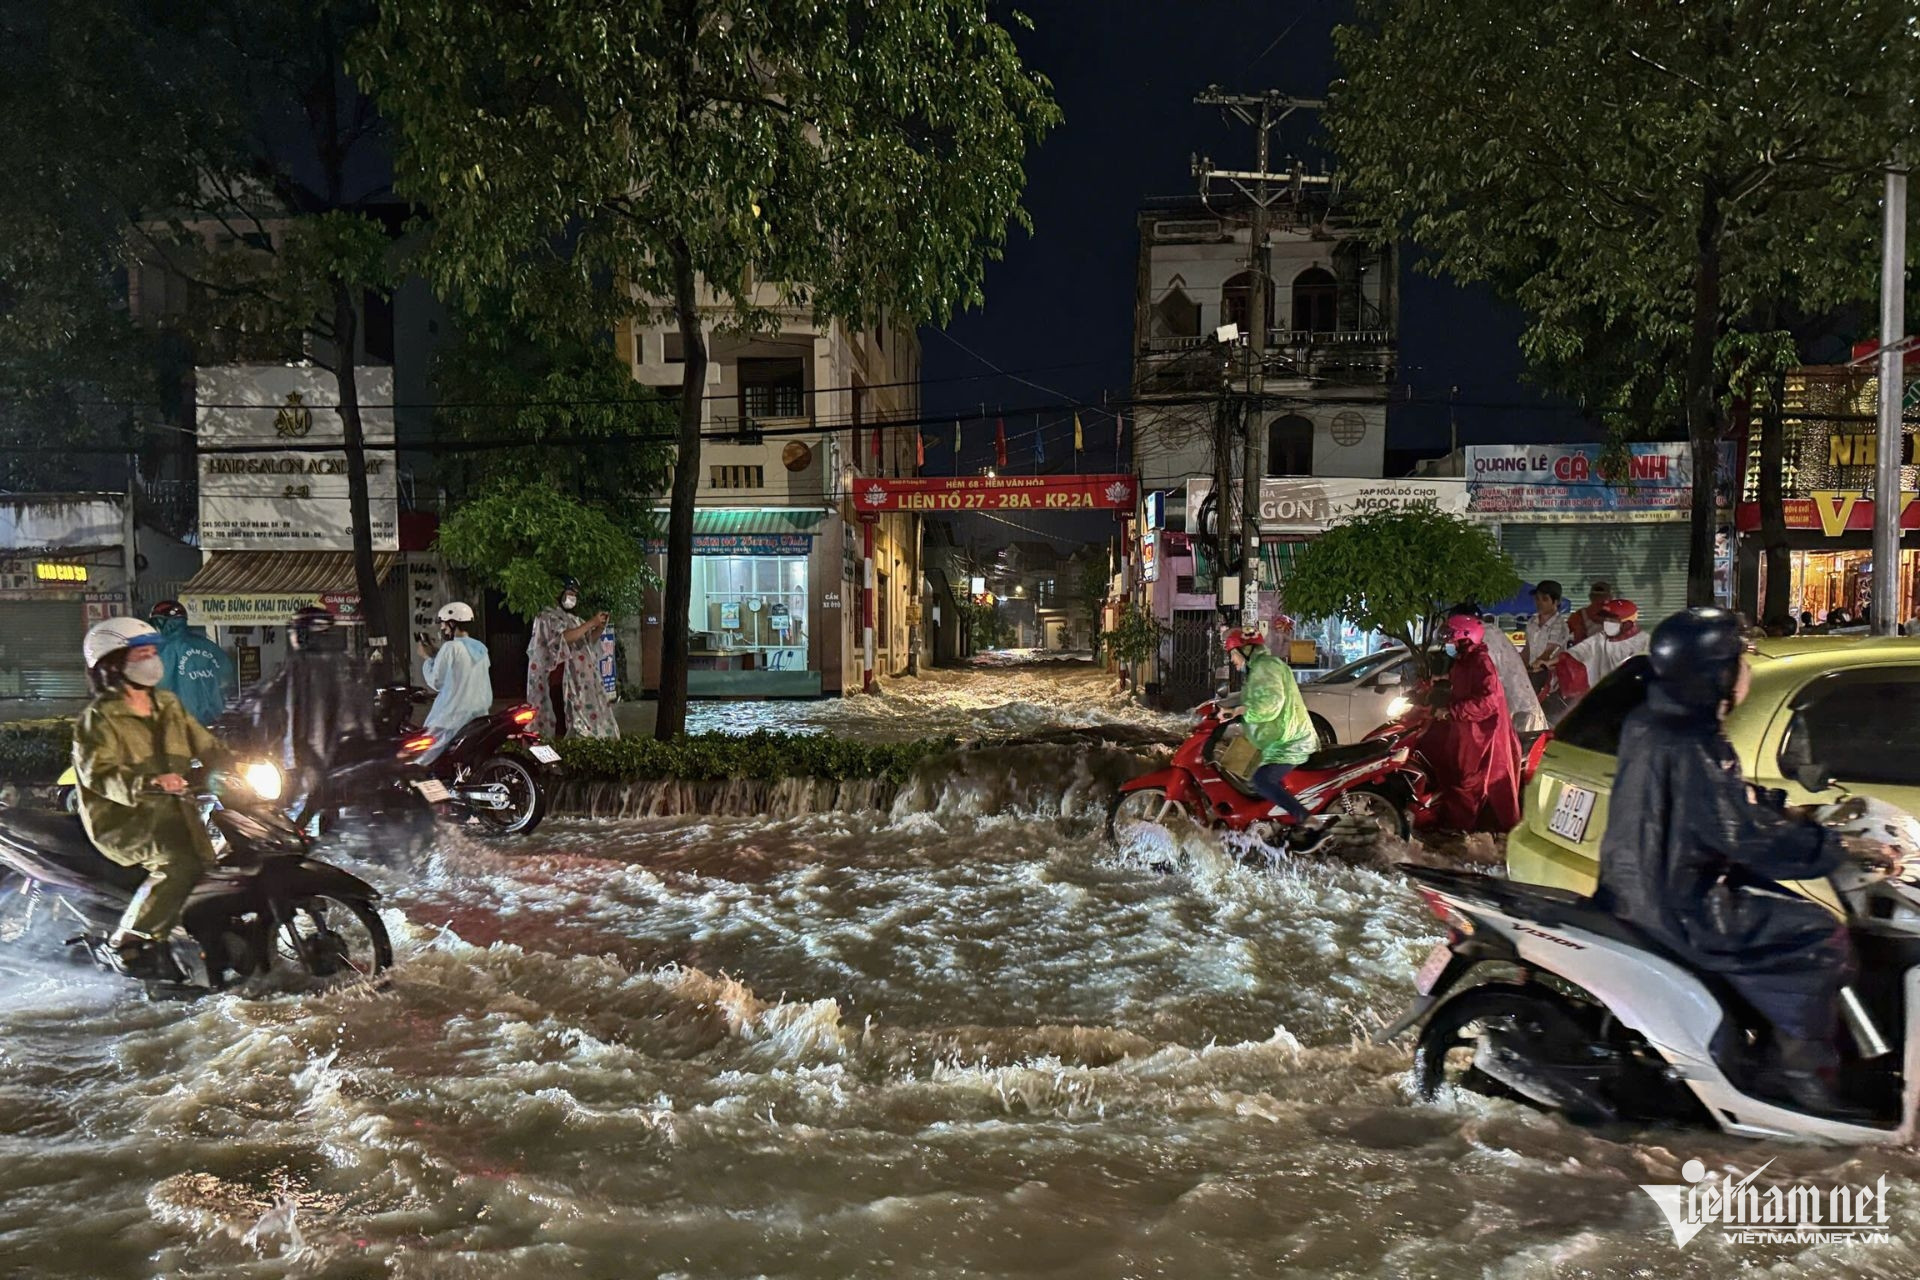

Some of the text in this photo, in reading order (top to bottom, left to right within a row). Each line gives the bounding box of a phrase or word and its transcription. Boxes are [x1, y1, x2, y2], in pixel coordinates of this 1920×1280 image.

[208, 459, 247, 474] HAIR
[248, 459, 306, 474] SALON
[1474, 450, 1670, 482] QUANG LÊ CÁ CNH
[1006, 478, 1025, 487] VĂN
[898, 492, 935, 509] LIÊN
[938, 489, 961, 508] TỔ
[965, 493, 985, 508] 27
[998, 493, 1031, 508] 28A
[1045, 493, 1094, 508] KP.2A
[1377, 487, 1396, 495] HÓA
[1413, 488, 1437, 496] CHƠI
[1260, 499, 1315, 520] GON
[254, 600, 275, 612] KHAI
[1511, 921, 1586, 950] VISION
